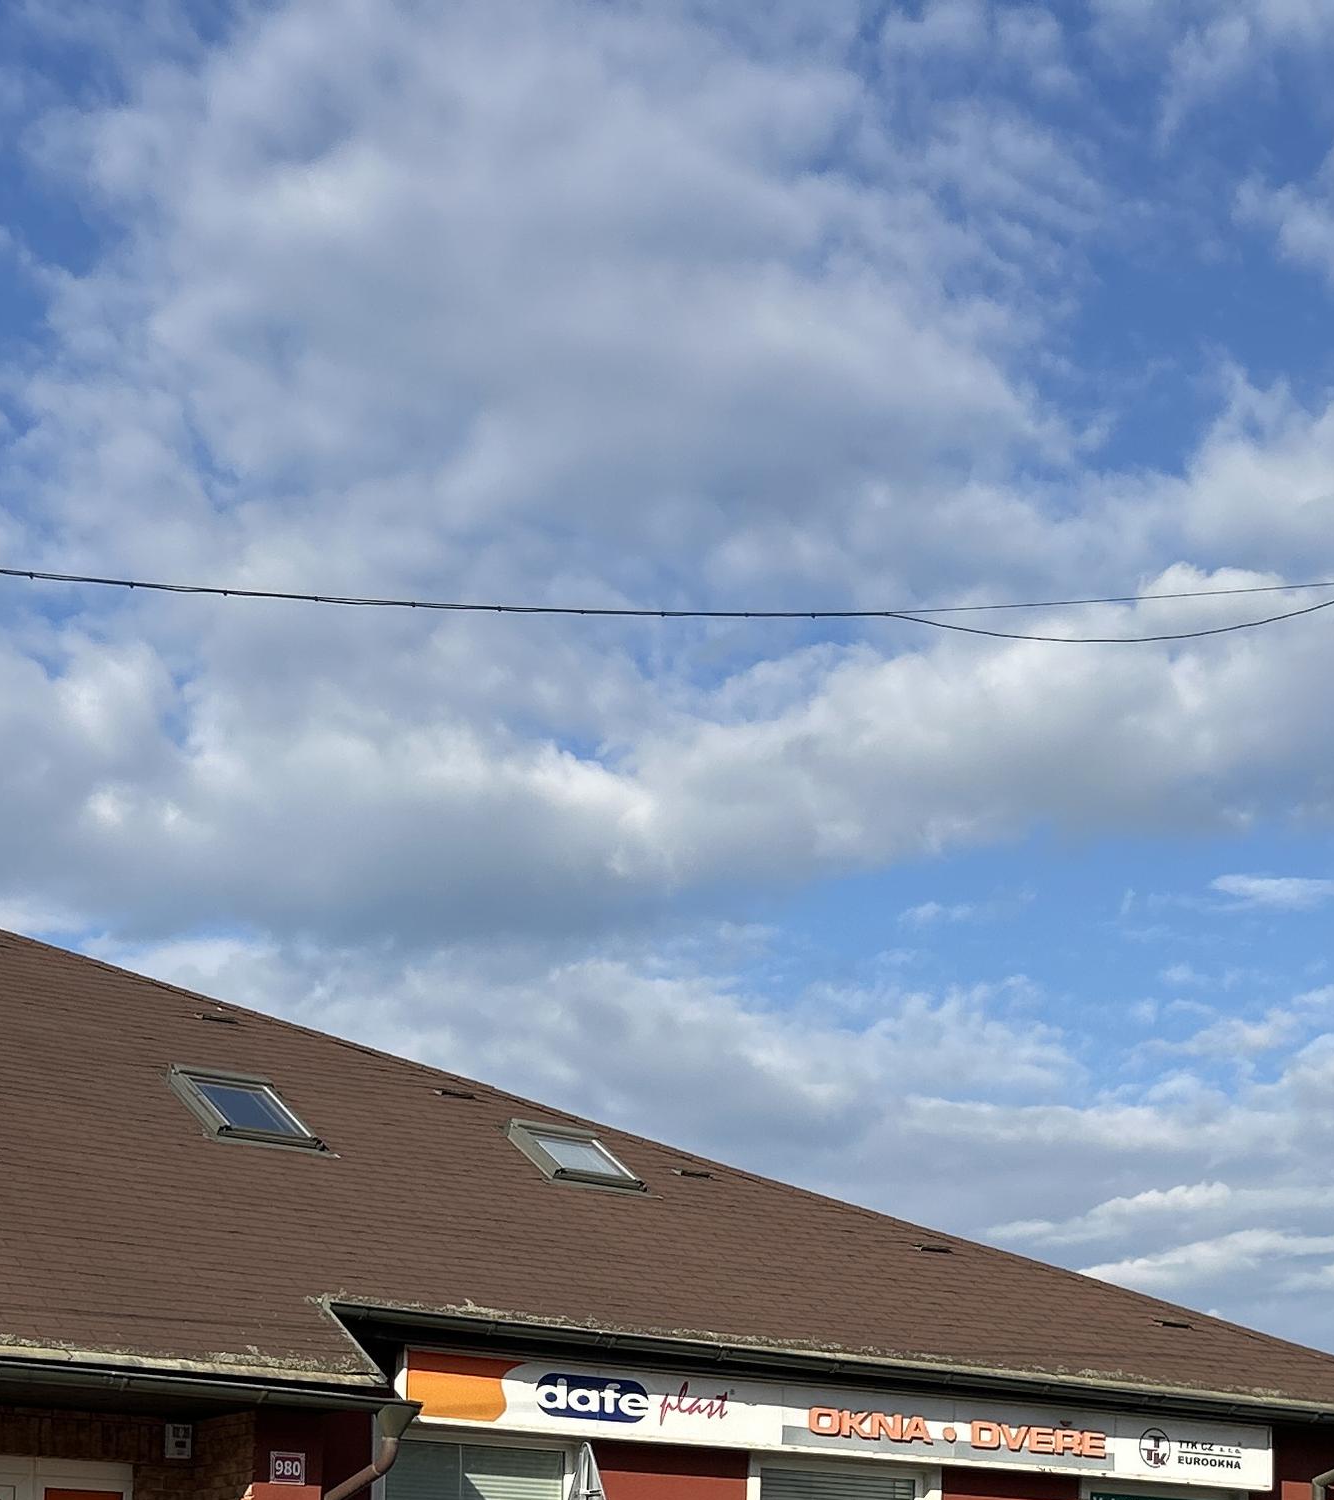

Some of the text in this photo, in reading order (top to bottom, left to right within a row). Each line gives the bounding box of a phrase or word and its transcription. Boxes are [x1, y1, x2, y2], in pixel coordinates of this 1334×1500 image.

[536, 1378, 729, 1426] dafe plast
[809, 1406, 1107, 1459] OKNA DVEŘE
[1201, 1442, 1214, 1452] CZ
[275, 1460, 301, 1476] 980
[1178, 1455, 1241, 1470] EUROOKNA
